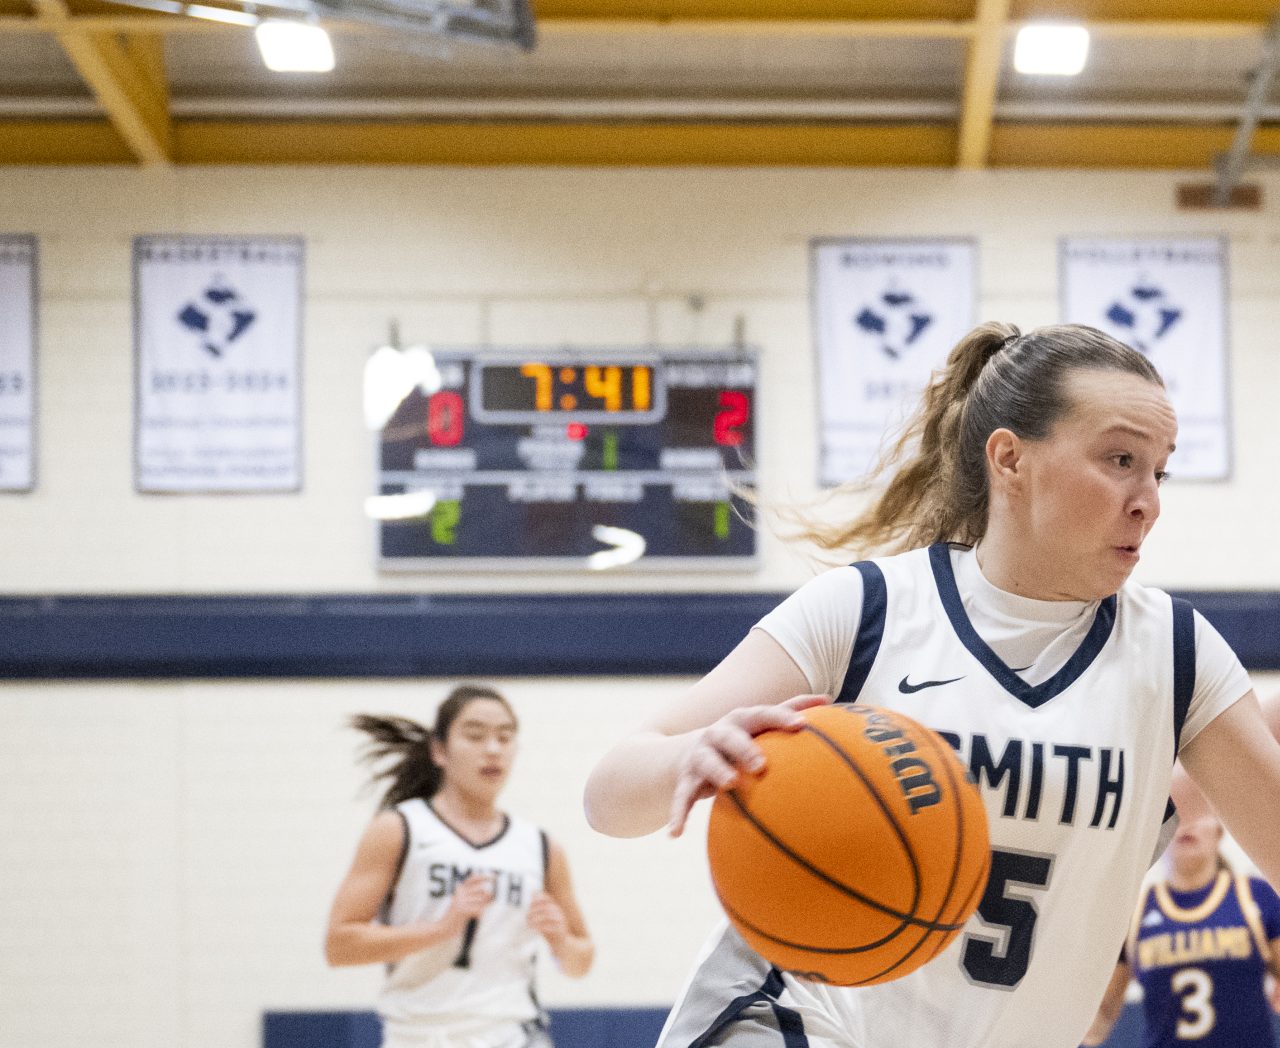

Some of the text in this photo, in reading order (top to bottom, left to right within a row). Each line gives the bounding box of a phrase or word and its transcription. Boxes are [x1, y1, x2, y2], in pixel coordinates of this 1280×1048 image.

[520, 363, 651, 412] 7:41
[428, 391, 464, 447] 0
[713, 390, 750, 446] 2
[958, 845, 1056, 992] 5
[1171, 967, 1217, 1041] 3
